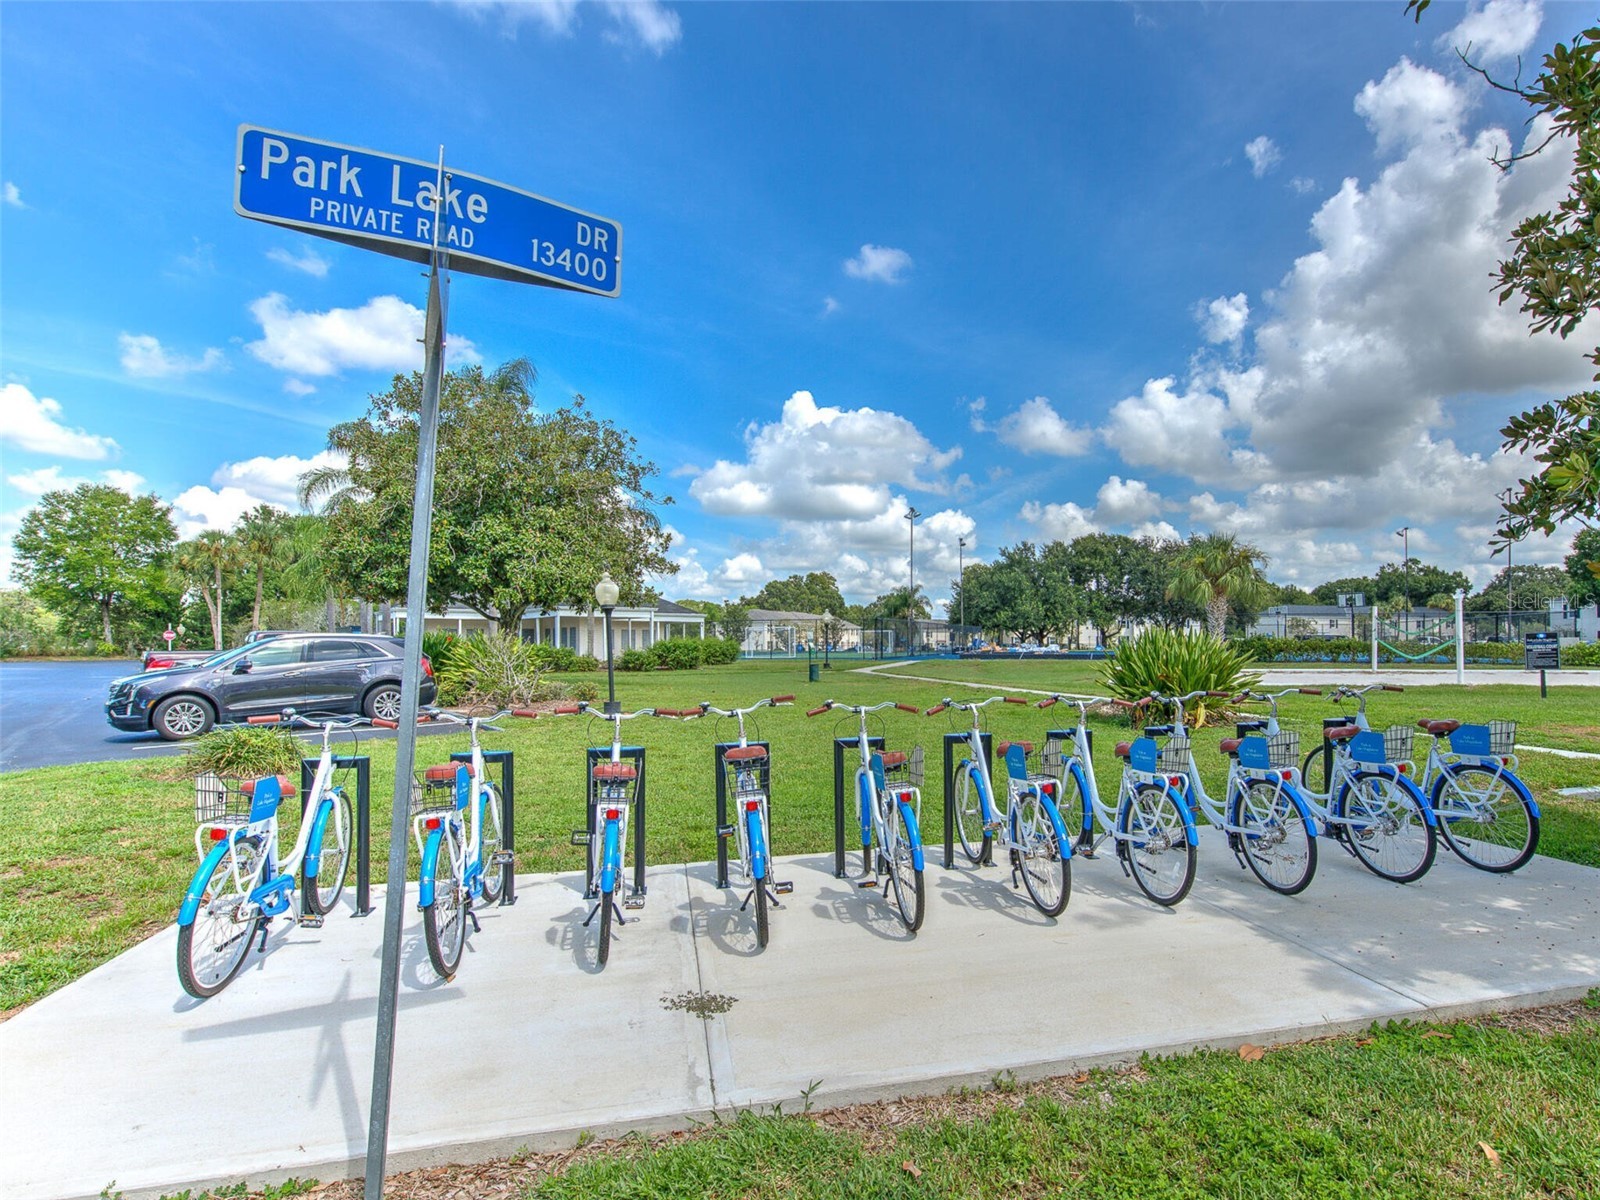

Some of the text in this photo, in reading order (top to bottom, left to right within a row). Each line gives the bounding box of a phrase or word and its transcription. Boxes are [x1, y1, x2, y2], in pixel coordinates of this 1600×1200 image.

[260, 137, 489, 224] Park Lake
[310, 197, 474, 249] PRIVATE RAD
[576, 221, 609, 252] DR
[531, 238, 607, 282] 13400
